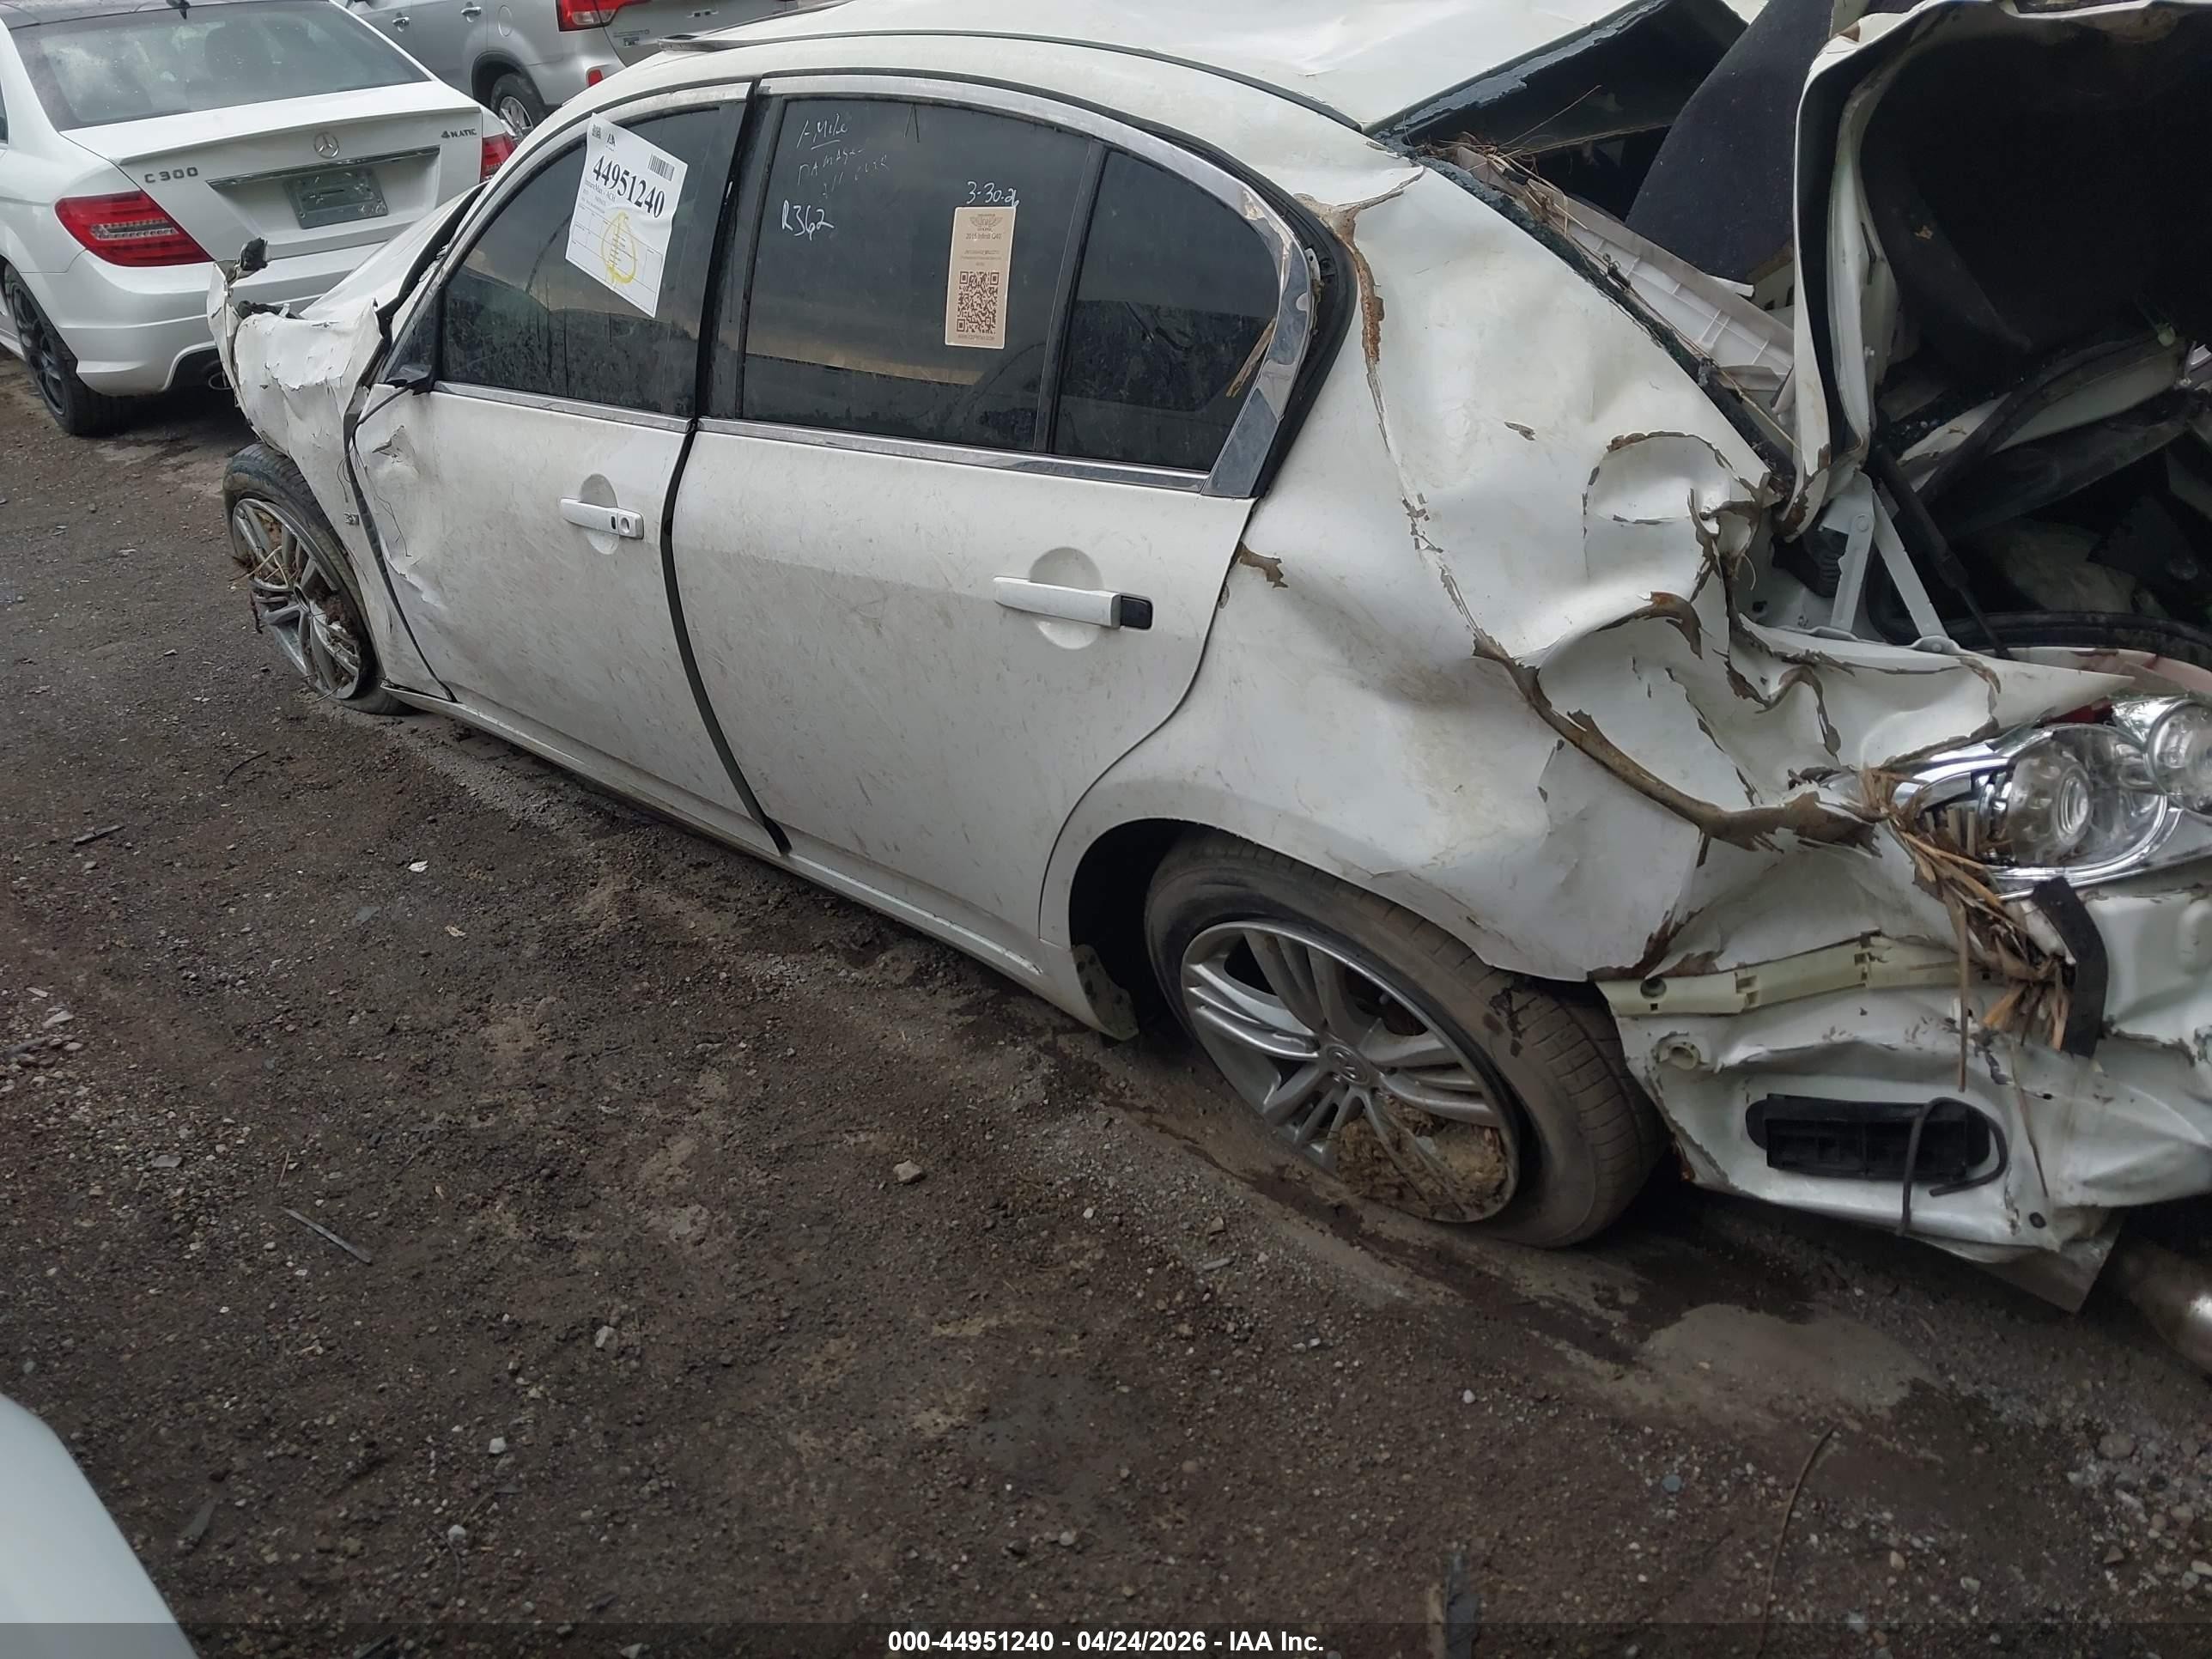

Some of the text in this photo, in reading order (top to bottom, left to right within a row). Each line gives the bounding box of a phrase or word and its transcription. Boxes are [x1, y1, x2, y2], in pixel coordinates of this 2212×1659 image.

[441, 128, 477, 138] 4MATIC
[144, 167, 198, 184] C 300
[592, 155, 665, 219] 44951240
[781, 198, 835, 241] R362
